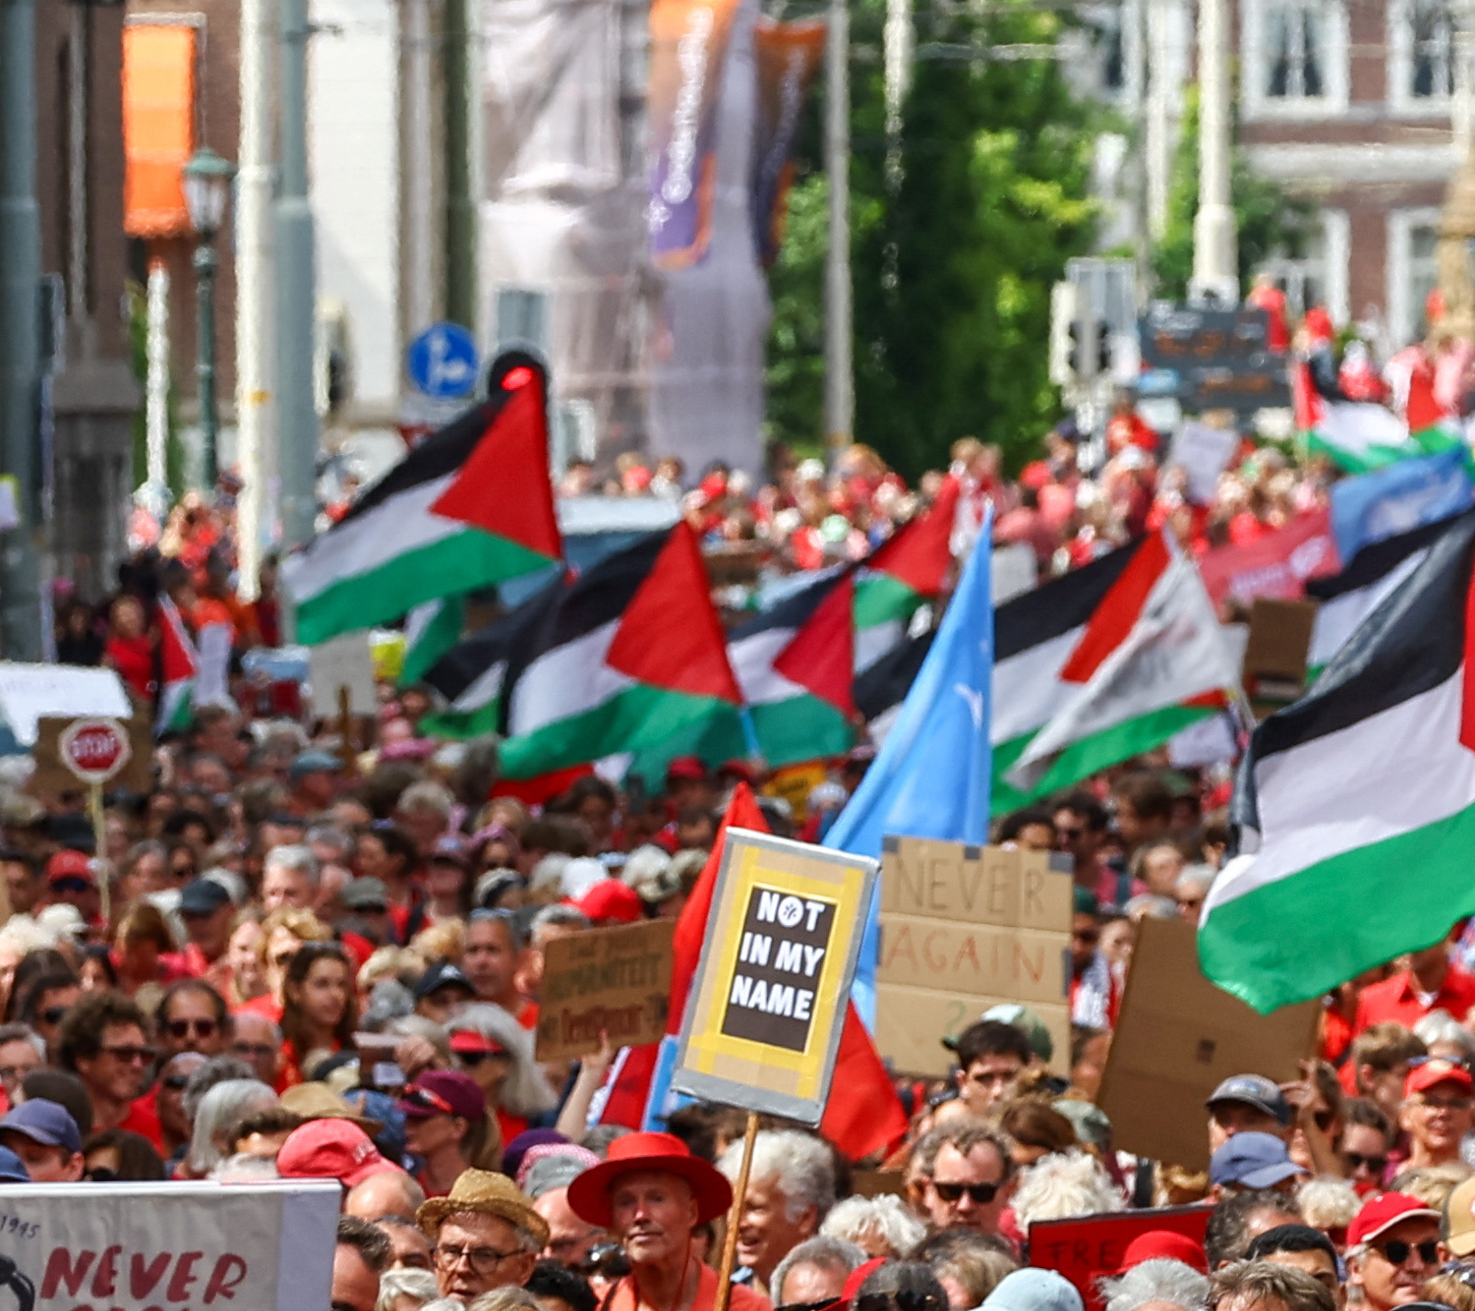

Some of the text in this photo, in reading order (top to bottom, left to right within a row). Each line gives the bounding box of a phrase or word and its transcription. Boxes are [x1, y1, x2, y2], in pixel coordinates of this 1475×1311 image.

[756, 891, 826, 932] NOT
[896, 857, 1046, 917] NEVER
[739, 932, 826, 977] IN MY
[882, 925, 1046, 985] AGAIN
[729, 975, 814, 1021] NAME
[40, 1245, 248, 1306] NEVER
